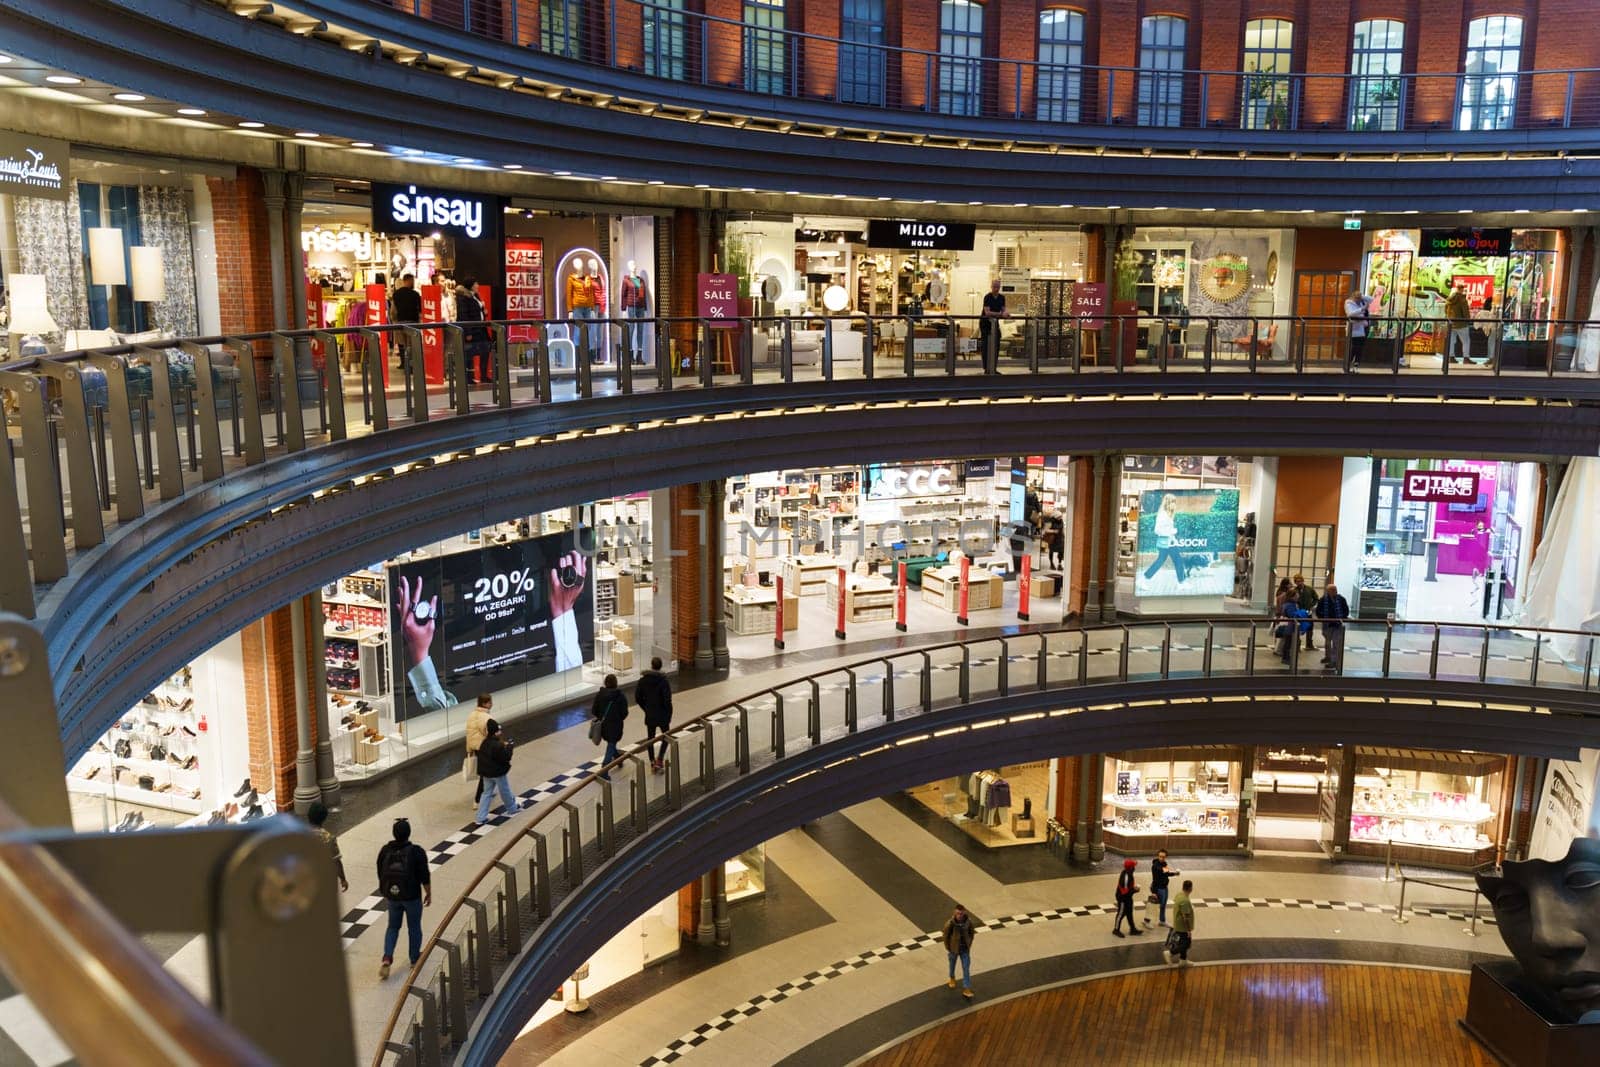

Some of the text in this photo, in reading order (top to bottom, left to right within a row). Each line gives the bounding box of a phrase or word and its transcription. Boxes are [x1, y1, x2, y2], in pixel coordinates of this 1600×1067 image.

[392, 185, 482, 238] sinsay
[899, 224, 947, 237] MILOO
[508, 251, 538, 265] SALE
[509, 274, 539, 287] SALE
[704, 291, 732, 300] SALE
[1077, 297, 1101, 306] SALE
[510, 296, 539, 309] SALE
[889, 467, 951, 496] CCC
[1430, 477, 1473, 488] TIME
[1430, 487, 1472, 496] TREND
[464, 567, 534, 603] -20%
[474, 595, 526, 615] NA ZEGARKI
[485, 612, 497, 621] OD
